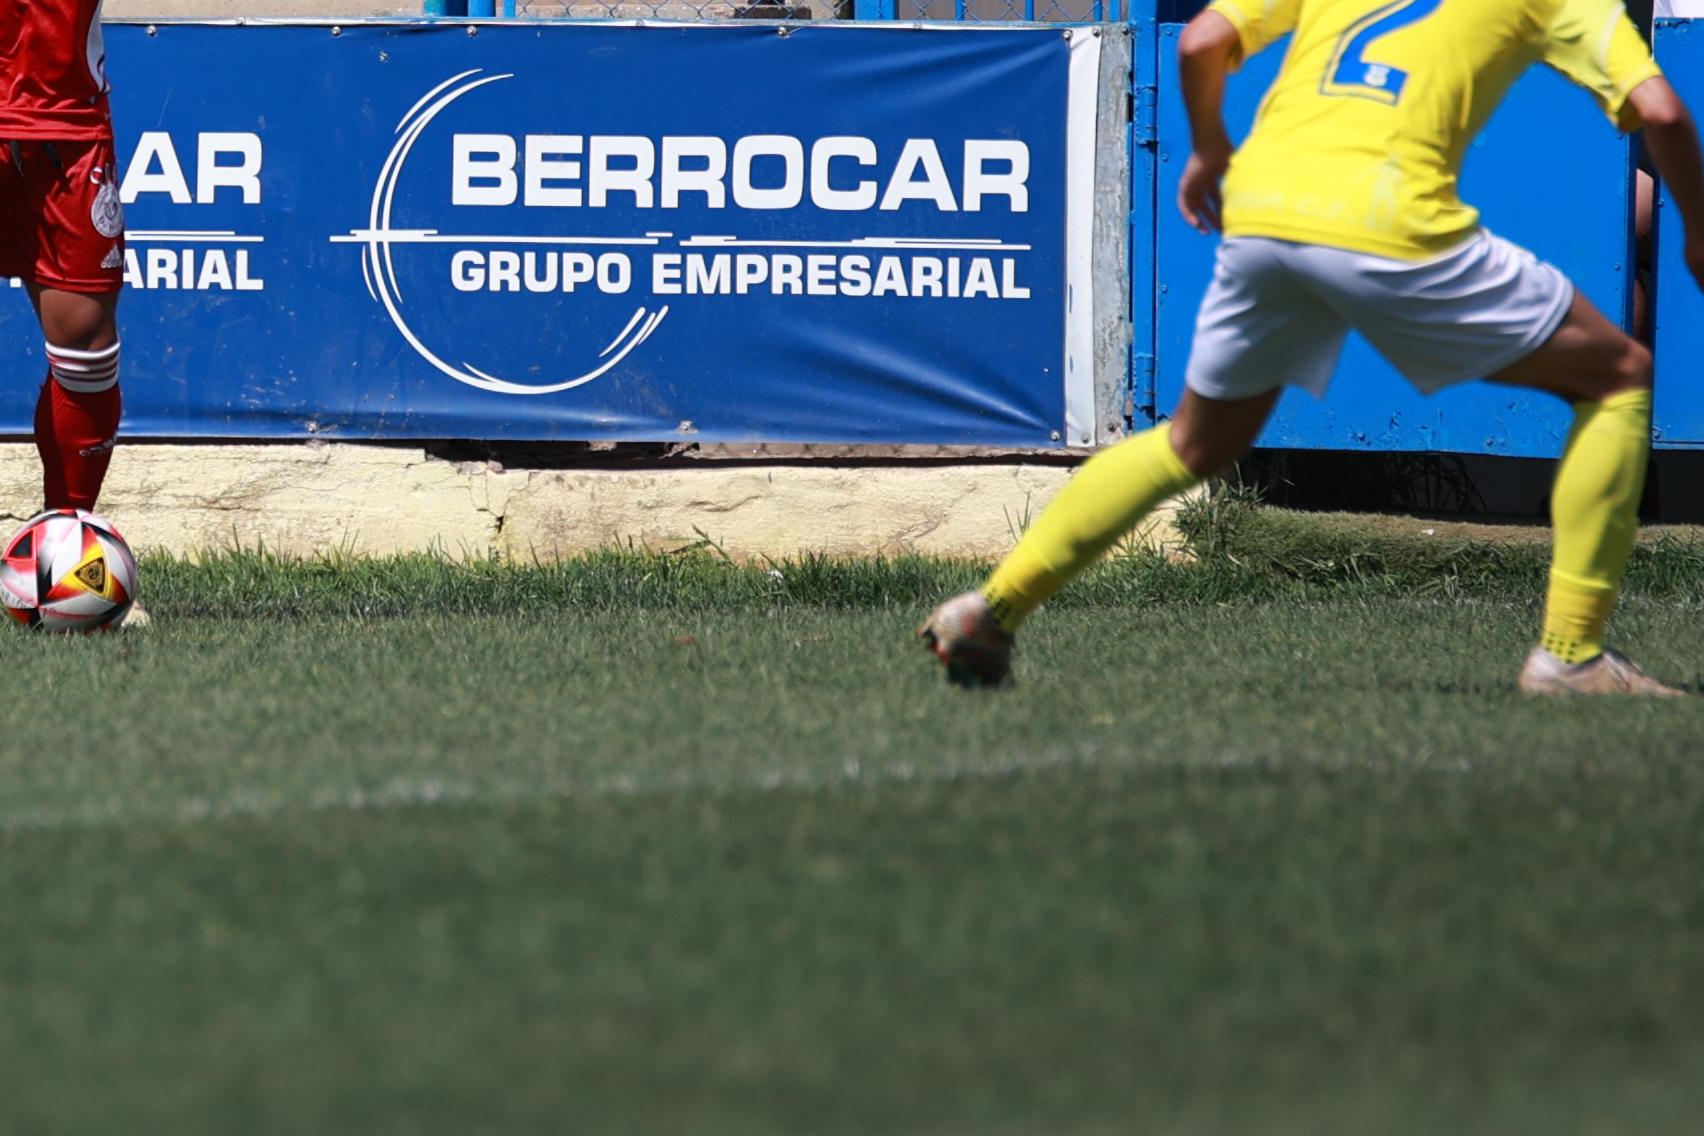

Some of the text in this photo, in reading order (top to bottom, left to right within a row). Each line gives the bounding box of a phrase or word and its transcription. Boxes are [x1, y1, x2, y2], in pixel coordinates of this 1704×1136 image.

[452, 133, 1030, 212] BERROCAR
[451, 250, 1031, 299] GRUPO EMPRESARIAL
